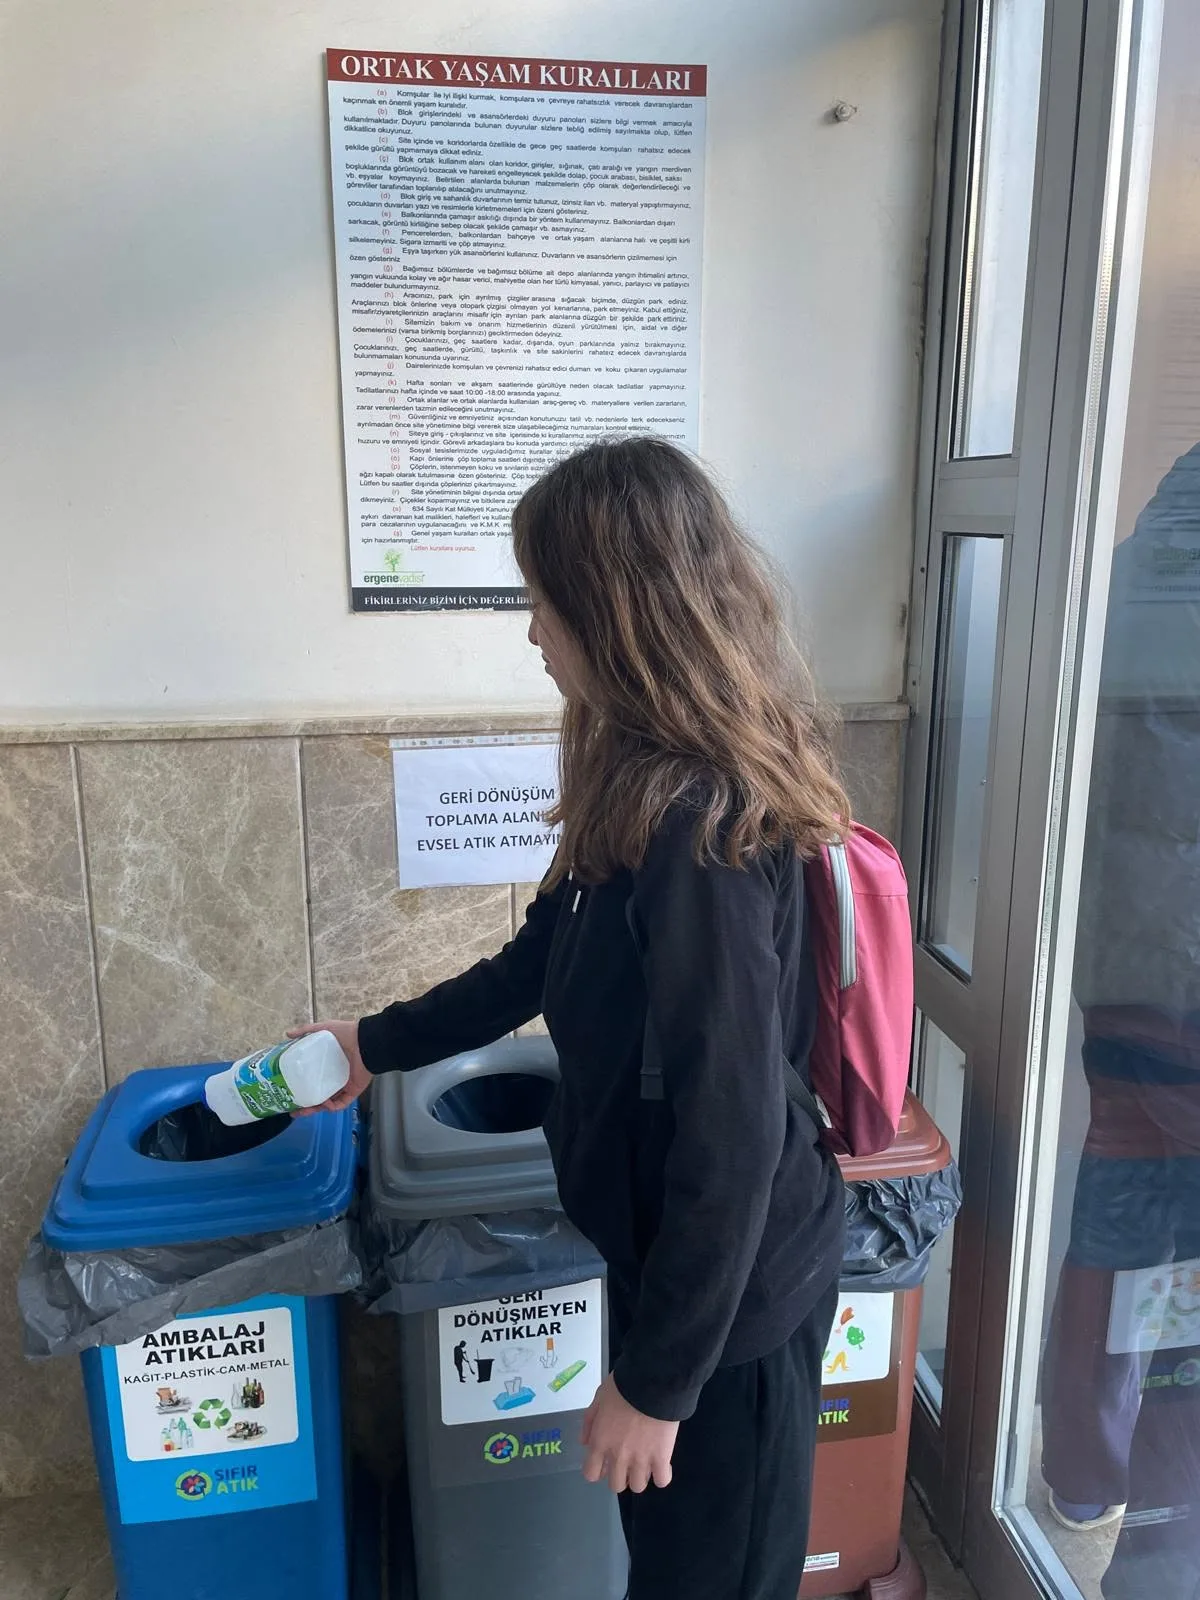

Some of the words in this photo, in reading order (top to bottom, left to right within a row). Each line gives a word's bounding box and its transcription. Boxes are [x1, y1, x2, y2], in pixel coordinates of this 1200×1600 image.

[340, 55, 434, 80] ORTAK
[439, 60, 531, 87] YAŞAM
[538, 64, 690, 91] KURALLARI
[364, 596, 428, 604] FİKİRLERİNİZ
[430, 595, 456, 604] BİZİM
[459, 595, 478, 606] İÇİN
[439, 788, 473, 805] GERİ
[477, 787, 555, 804] DÖNÜŞÜM
[426, 813, 498, 827] TOPLAMA
[417, 838, 460, 851] EVSEL
[463, 836, 496, 849] ATIK
[500, 833, 560, 847] ATMAYI
[454, 1300, 587, 1328] DÖNÜŞMEYEN
[142, 1321, 265, 1349] AMBALAJ
[480, 1321, 562, 1343] ATIKLAR
[144, 1338, 265, 1366] ATIKLARI
[124, 1358, 290, 1384] KAĞIT-PLASTİK-CAM-METAL
[819, 1398, 849, 1411] IFIR
[522, 1440, 562, 1458] ATIK
[214, 1465, 257, 1481] SIFIR
[216, 1476, 259, 1495] ATIK
